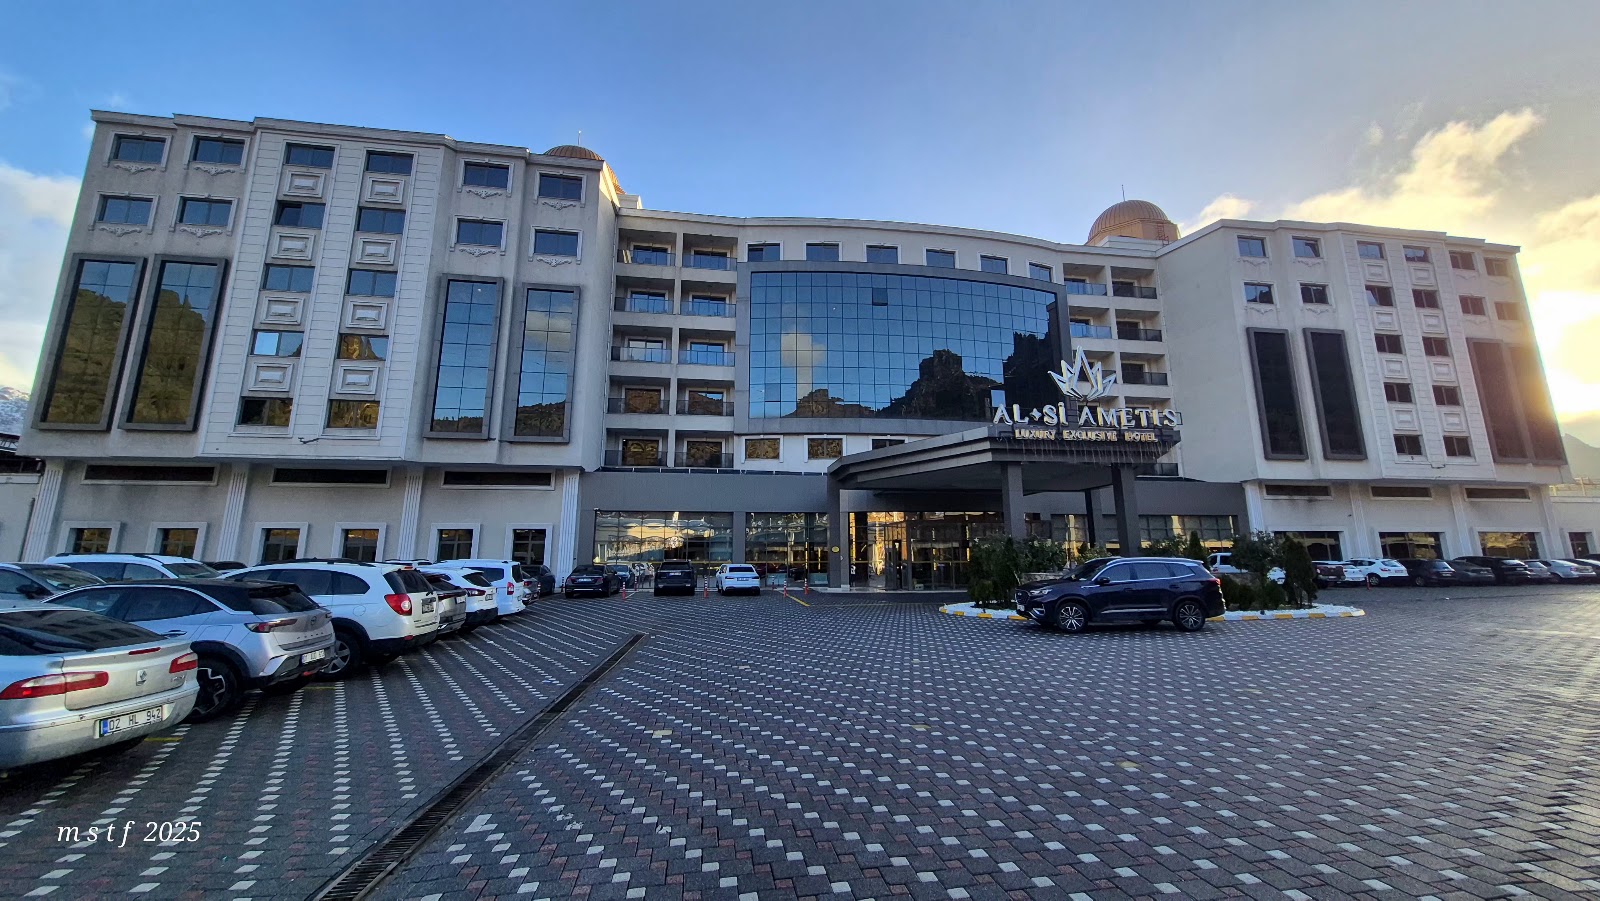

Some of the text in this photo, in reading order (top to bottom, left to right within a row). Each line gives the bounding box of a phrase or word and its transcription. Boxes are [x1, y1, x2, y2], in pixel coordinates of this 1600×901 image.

[1078, 405, 1178, 428] AMETIS
[1015, 429, 1158, 442] LUXURY EXCLUSIVE HOTEL
[109, 708, 161, 731] 02 HL 942
